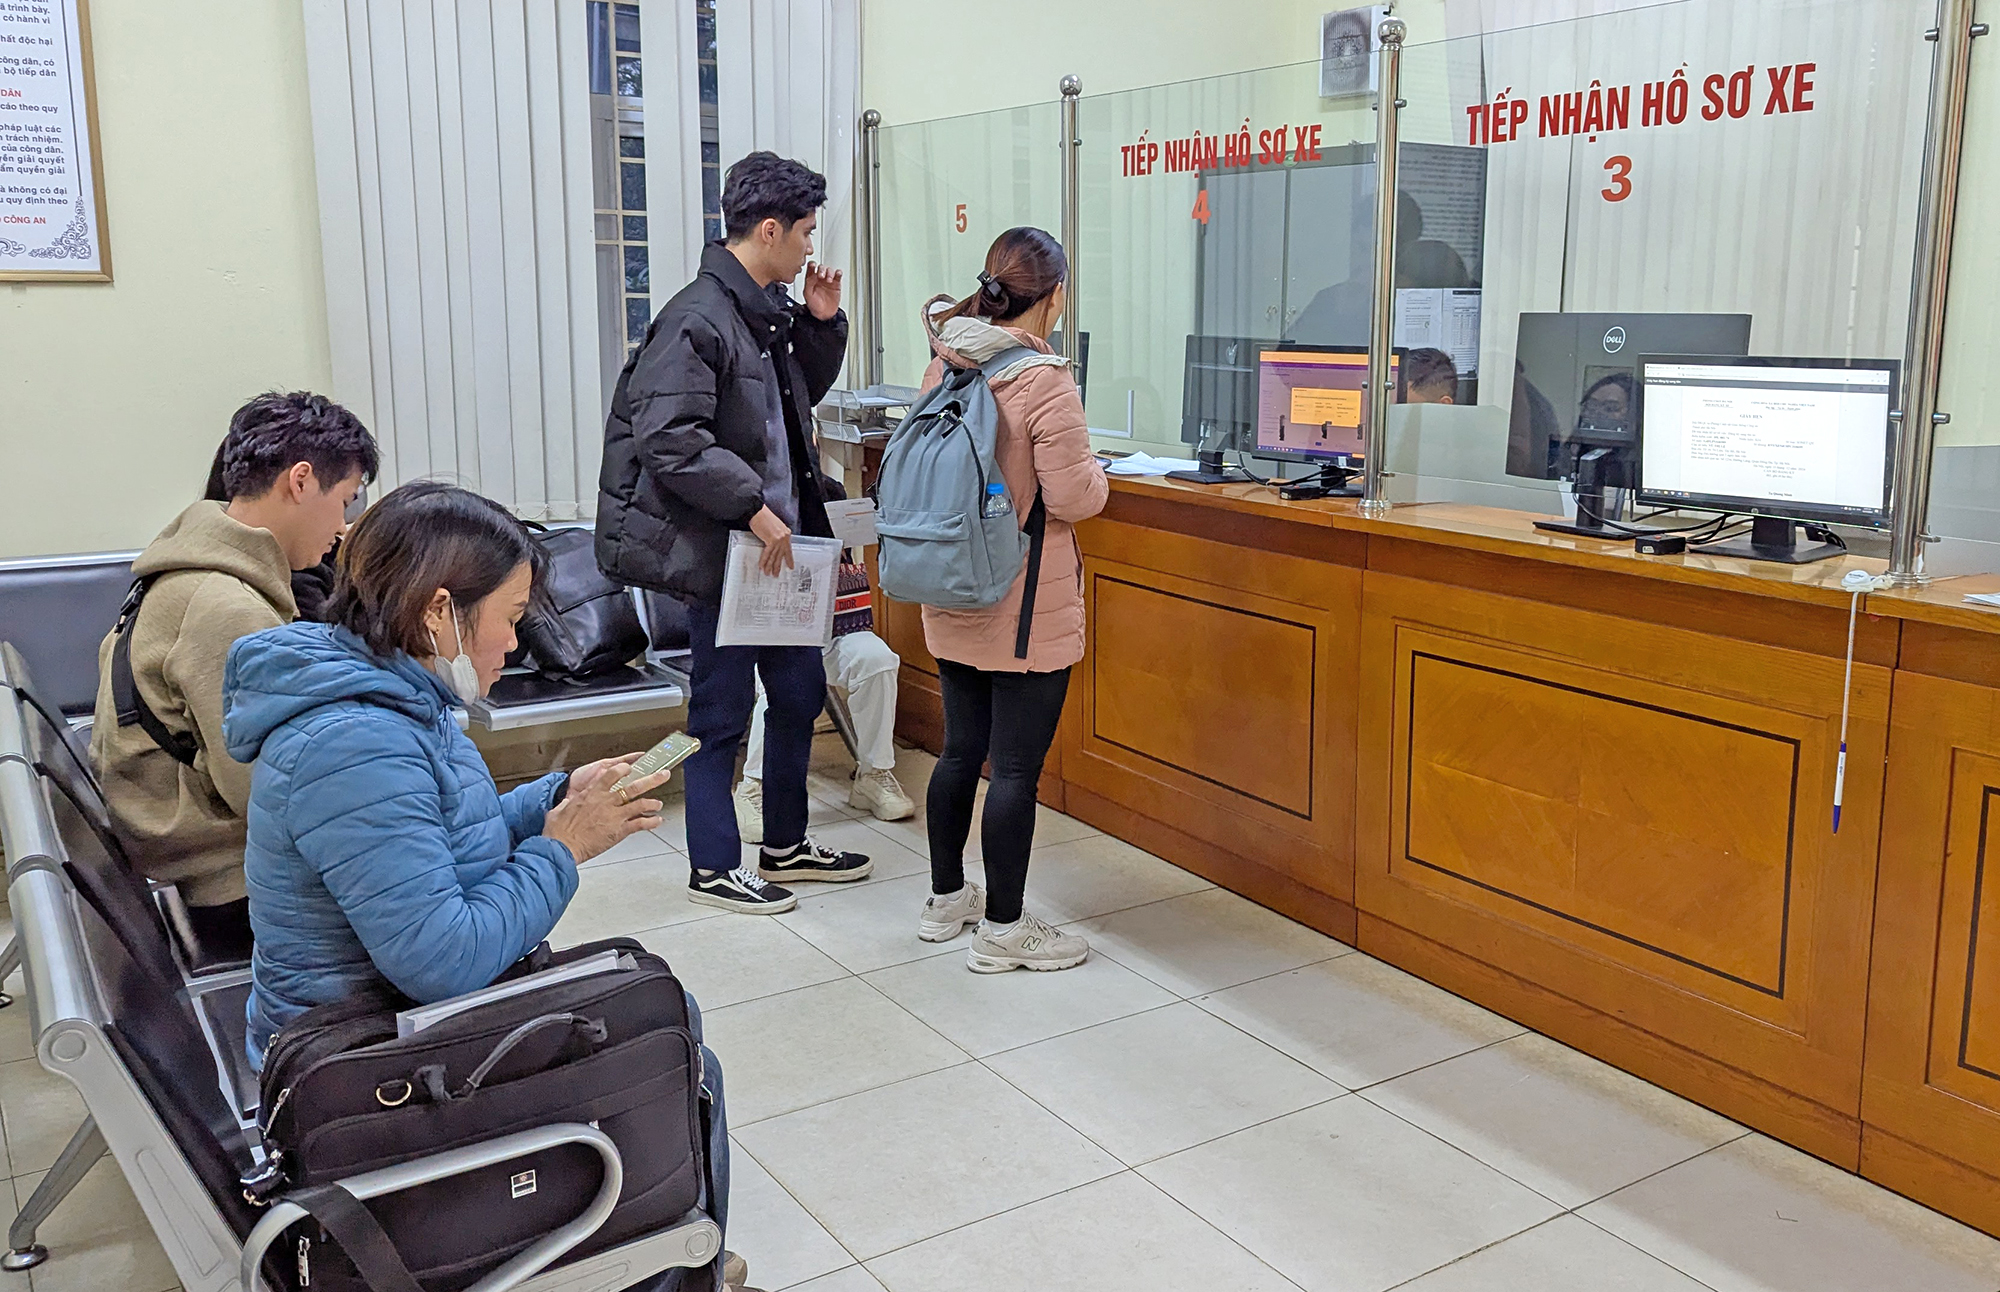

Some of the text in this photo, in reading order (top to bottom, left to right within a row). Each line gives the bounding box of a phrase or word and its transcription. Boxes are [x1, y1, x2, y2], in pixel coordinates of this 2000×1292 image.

[8, 4, 29, 12] trình
[32, 5, 50, 15] bày.
[17, 15, 39, 23] hành
[18, 36, 35, 45] độc
[38, 38, 53, 46] hại
[4, 67, 16, 76] bộ
[18, 67, 36, 77] tiếp
[0, 88, 21, 97] DÂN
[0, 102, 17, 110] cáo
[41, 106, 58, 114] quy
[1466, 61, 1816, 145] TIẾP NHẬN HỒ SƠ XE
[25, 124, 42, 134] luật
[45, 125, 61, 133] các
[5, 134, 29, 142] trách
[32, 135, 63, 144] nhiệm.
[1, 144, 64, 154] của công dân.
[1120, 117, 1322, 178] TIẾP NHẬN HỒ SƠ XE
[38, 156, 65, 165] quyết
[1601, 154, 1633, 203] 3
[8, 186, 37, 195] không
[53, 187, 68, 196] đại
[6, 197, 22, 205] quy
[25, 196, 46, 205] định
[1192, 189, 1212, 225] 4
[3, 214, 30, 224] CÔNG
[33, 216, 46, 224] AN
[955, 203, 967, 233] 5
[1606, 335, 1622, 344] DELL
[1021, 935, 1042, 951] N
